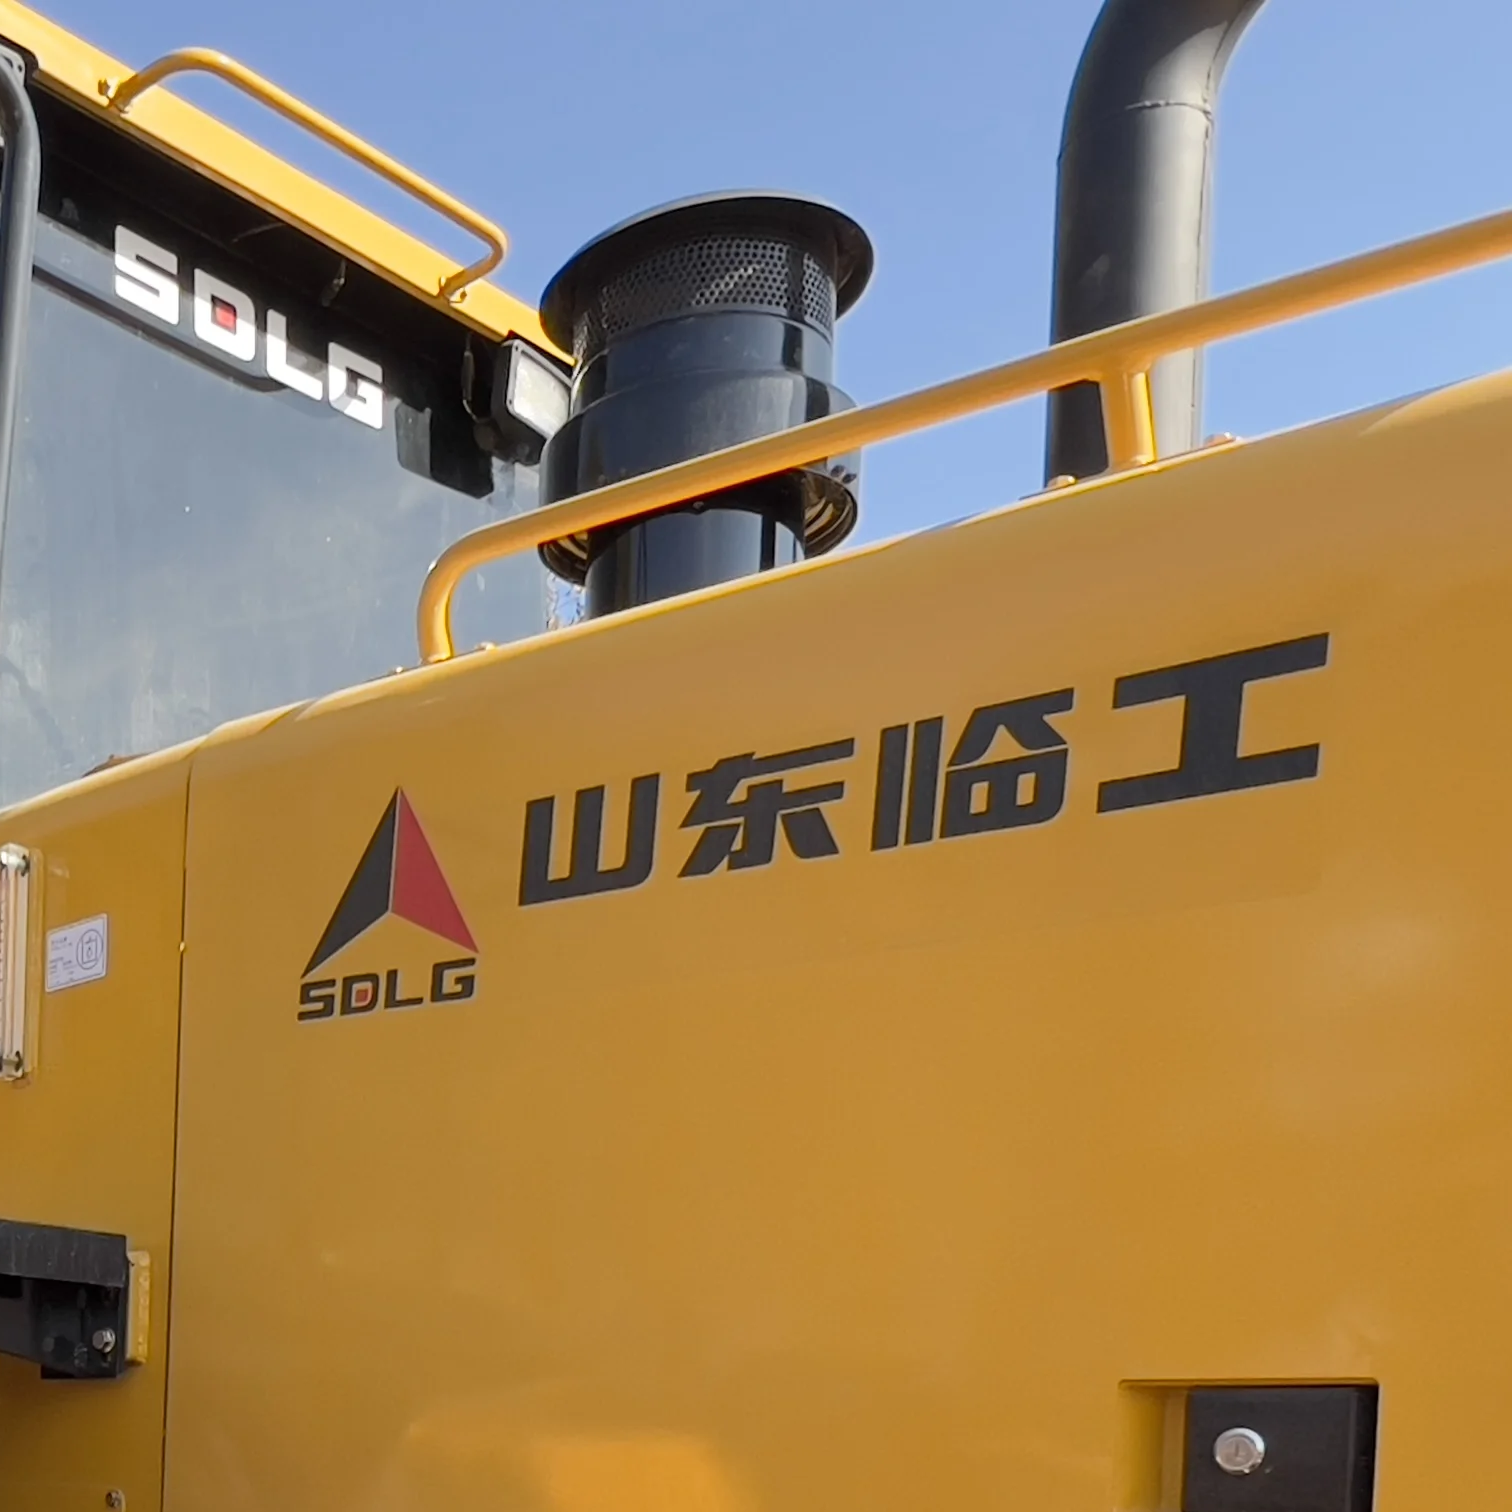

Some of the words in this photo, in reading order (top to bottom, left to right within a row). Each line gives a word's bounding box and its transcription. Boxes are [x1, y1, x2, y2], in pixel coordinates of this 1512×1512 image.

[115, 224, 383, 430] SDLG
[517, 632, 1330, 907] 山东临工
[297, 957, 476, 1021] SDLG
